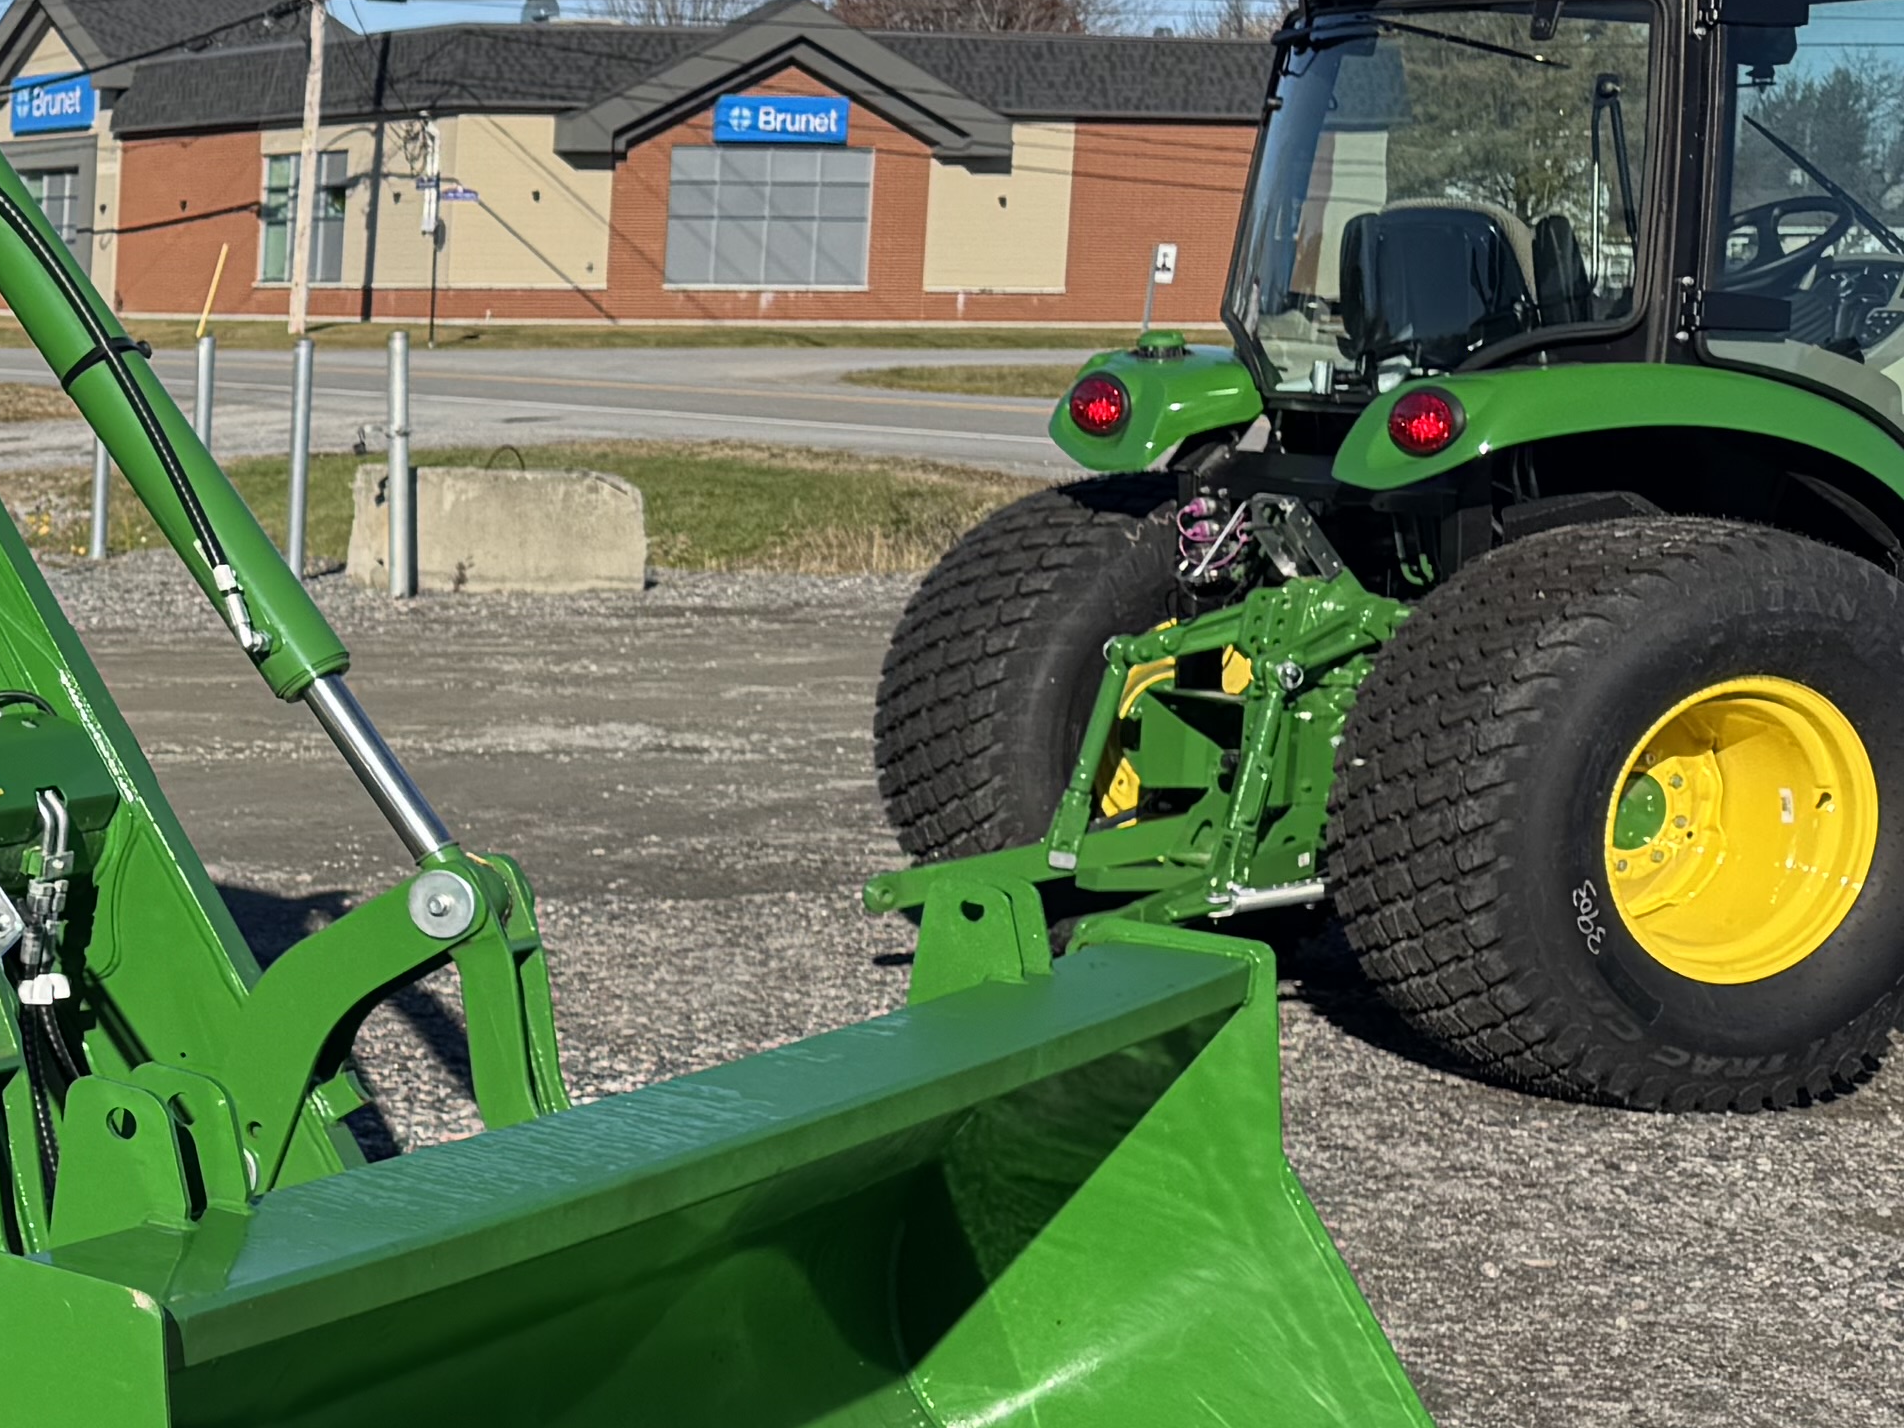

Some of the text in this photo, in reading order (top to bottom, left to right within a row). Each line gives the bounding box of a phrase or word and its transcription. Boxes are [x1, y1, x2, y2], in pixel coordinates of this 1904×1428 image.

[32, 85, 81, 117] Brunet
[757, 105, 838, 133] Brunet
[1572, 879, 1607, 955] 3903
